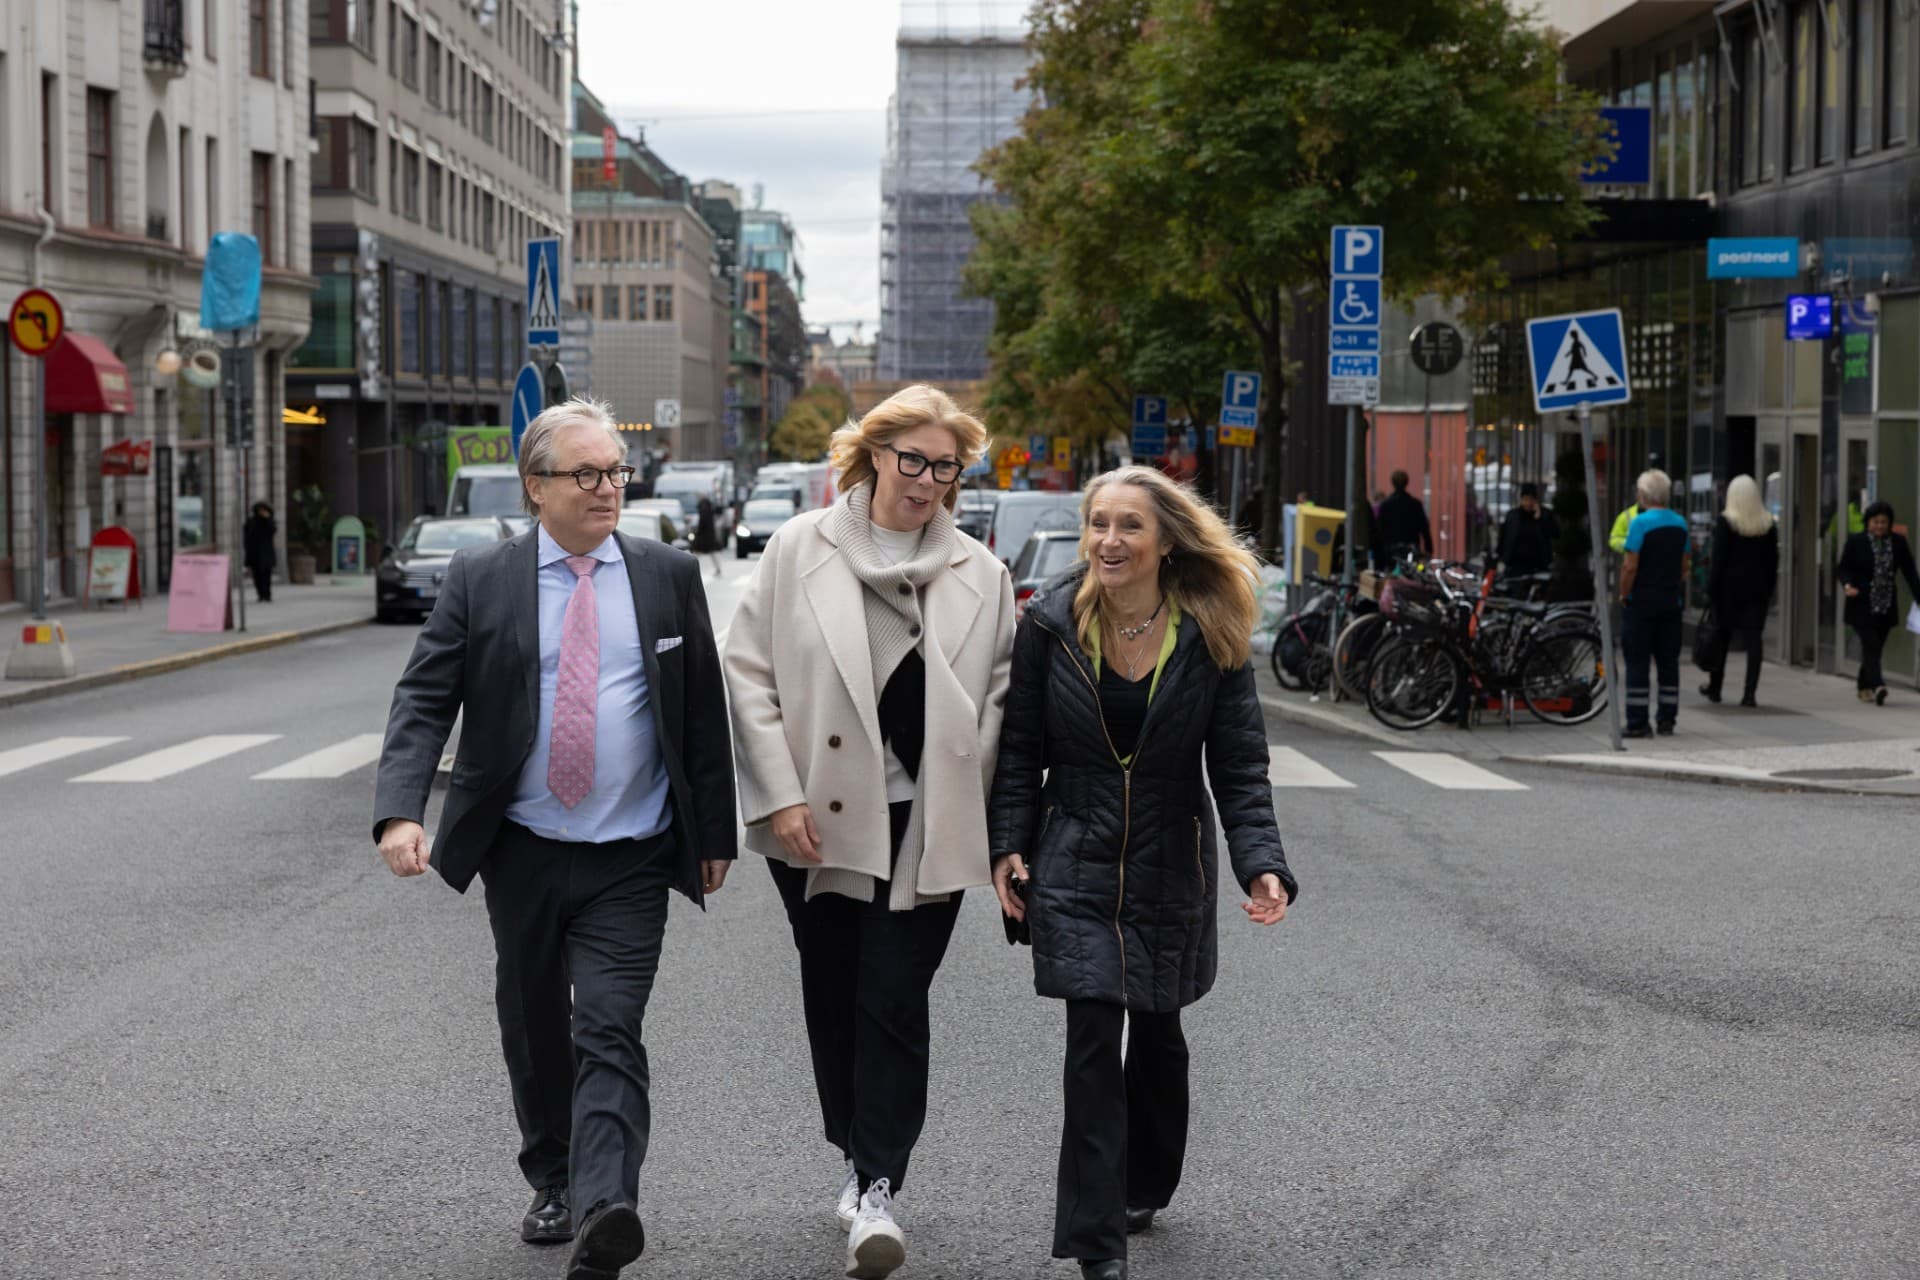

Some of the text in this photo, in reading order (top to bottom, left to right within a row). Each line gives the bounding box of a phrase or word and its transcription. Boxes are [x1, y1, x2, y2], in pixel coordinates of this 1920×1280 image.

[1344, 231, 1373, 271] P
[1718, 250, 1790, 265] postnord
[1791, 304, 1808, 325] P
[1233, 376, 1254, 405] P
[1143, 401, 1160, 421] P
